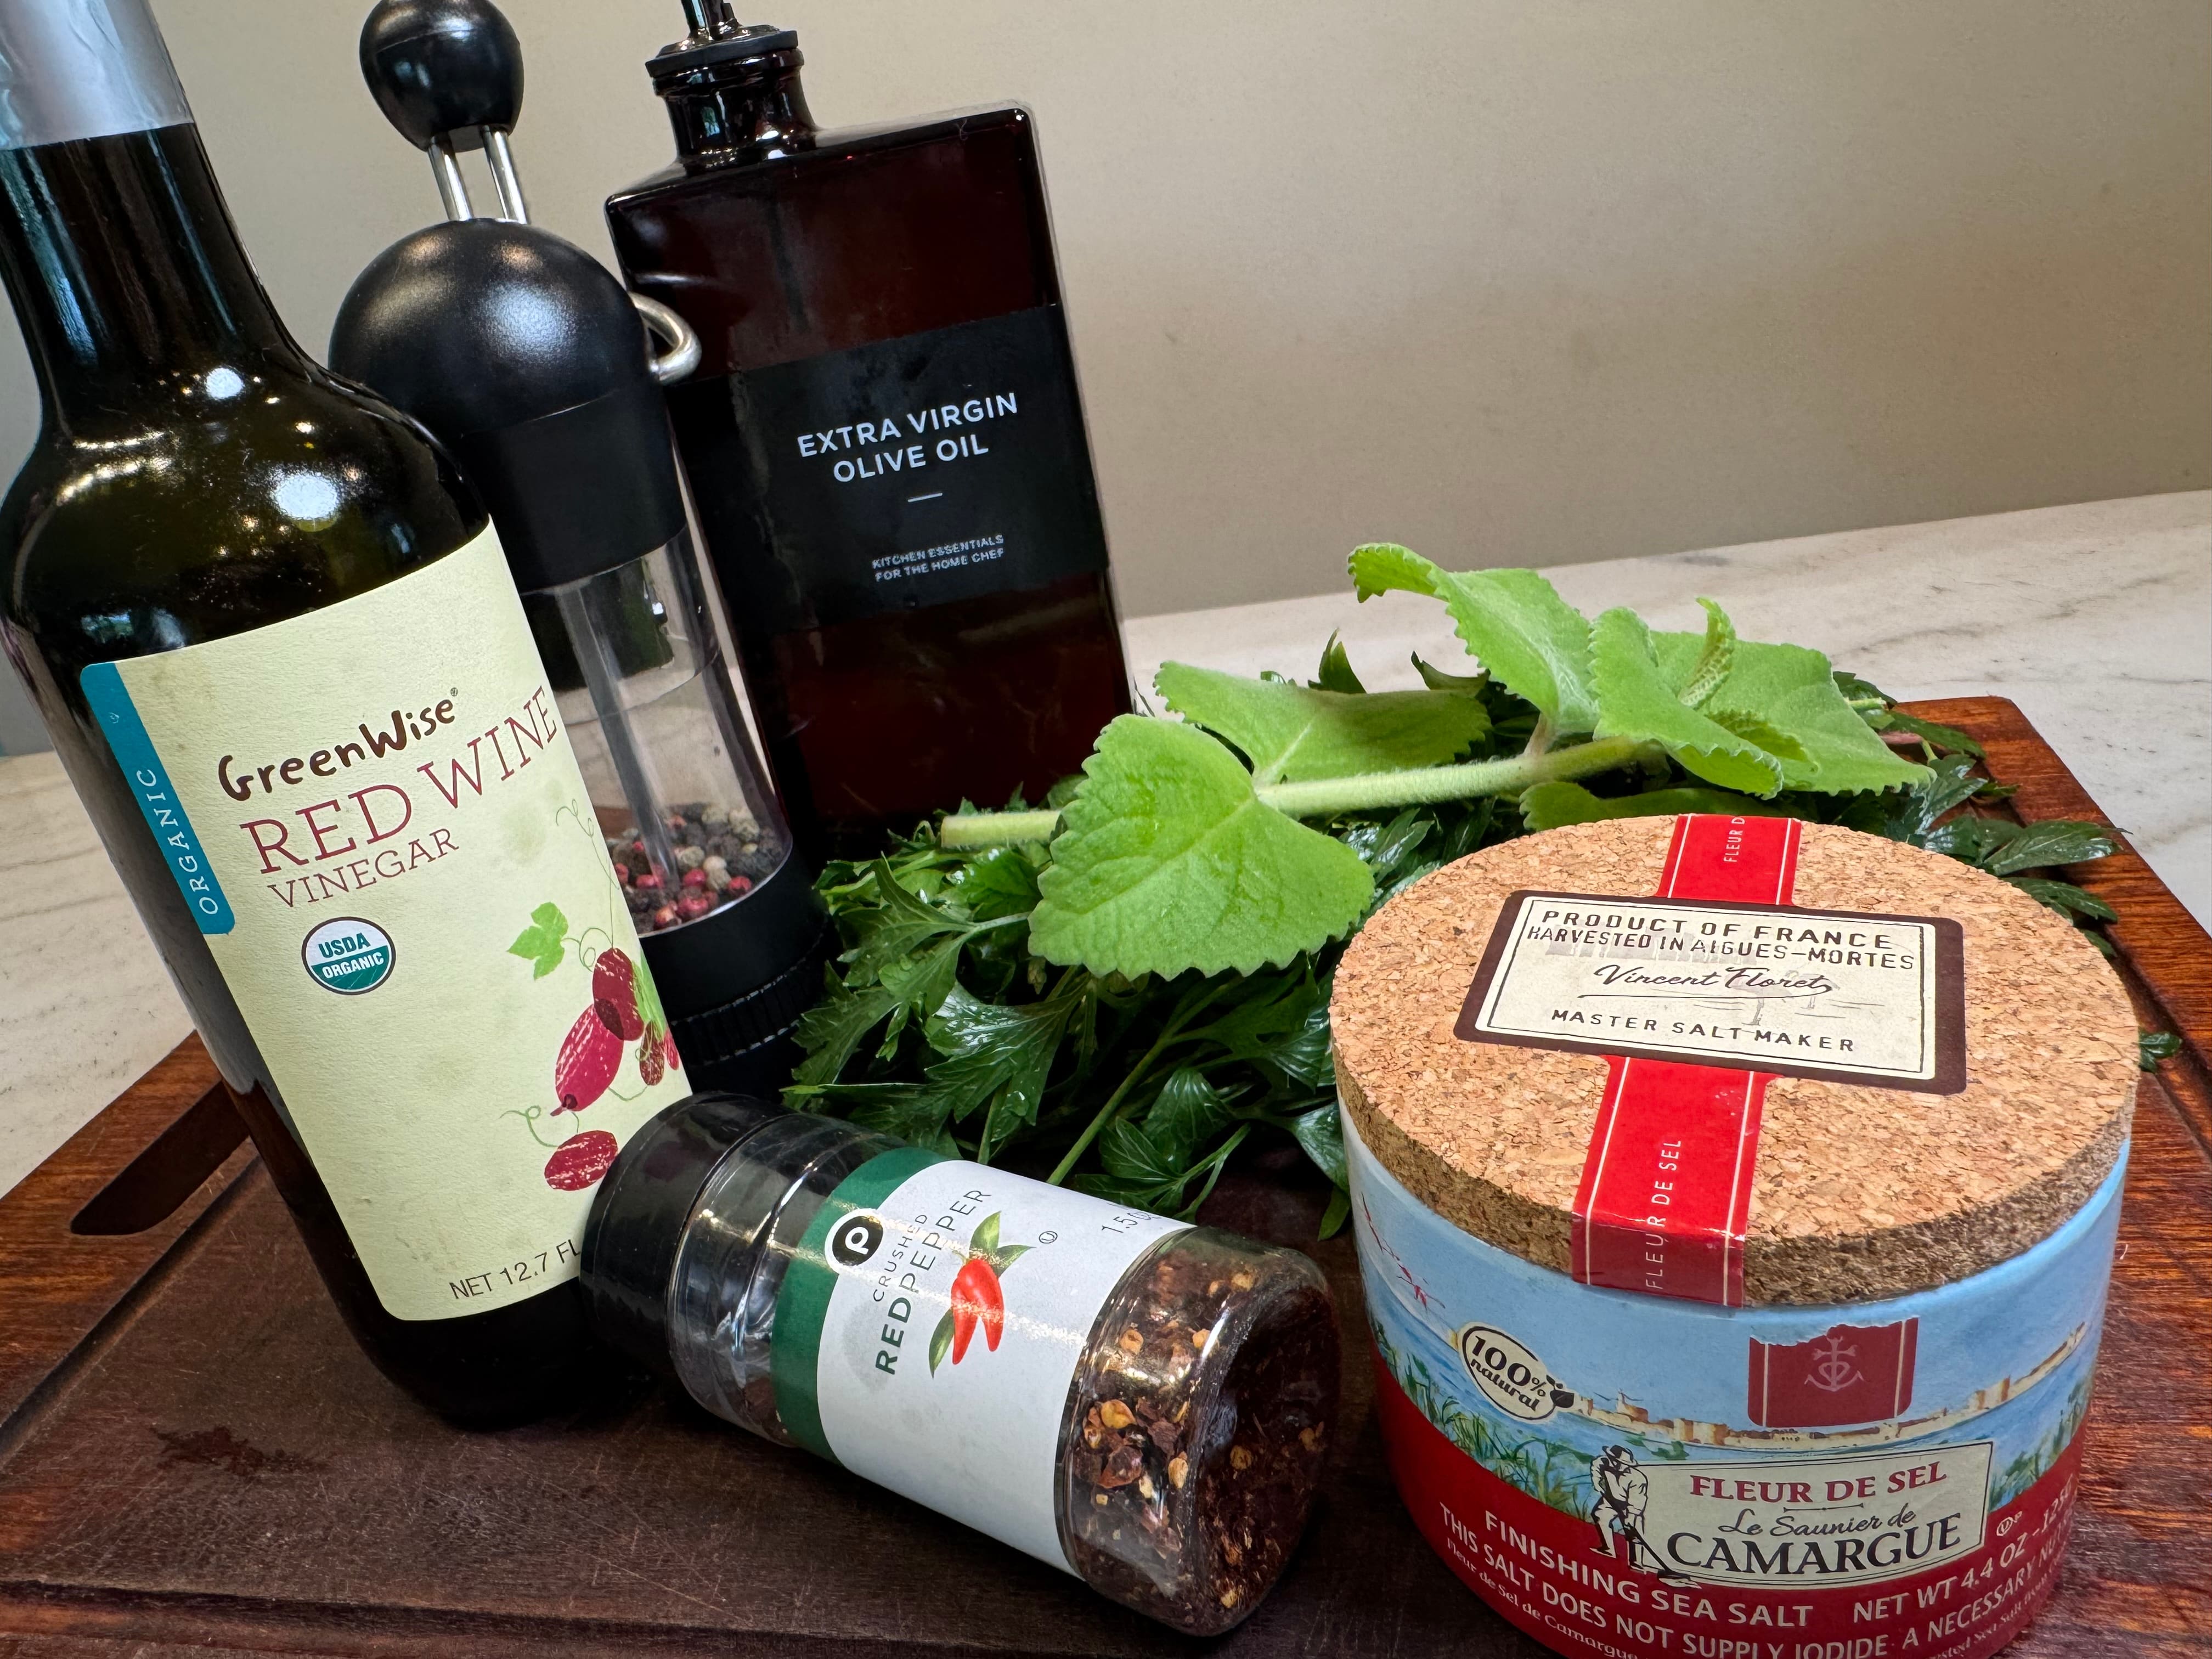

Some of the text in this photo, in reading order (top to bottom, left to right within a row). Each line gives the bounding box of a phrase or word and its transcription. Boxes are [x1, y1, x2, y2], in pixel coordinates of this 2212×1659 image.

[797, 392, 1018, 458] EXTRA VIRGIN
[833, 434, 989, 482] OLIVE OIL
[872, 534, 1004, 569] KITCHEN ESSENTIALS
[874, 548, 1004, 582] FOR THE HOME CHEF
[239, 685, 557, 874] RED WINE
[136, 769, 219, 915] ORGANIC
[267, 827, 459, 909] VINEGAR
[1723, 830, 1743, 862] FLEUR
[318, 933, 371, 958] USDA
[1527, 925, 1652, 948] HARVESTED
[1659, 935, 1684, 951] IN
[1542, 911, 1893, 950] PRODUCT OF FRANCE
[322, 952, 385, 979] ORGANIC
[1593, 964, 1722, 986] Vincent
[1551, 1009, 1854, 1052] MASTER SALT MAKER
[1645, 1140, 1681, 1290] FLEUR DE SEL
[449, 1239, 582, 1299] NET 12.7 FL
[873, 1214, 928, 1303] CRUSHED
[1470, 1358, 1541, 1412] natural
[1471, 1335, 1547, 1397] 100%
[1690, 1461, 1947, 1503] FLEUR DE SEL
[1667, 1512, 1961, 1575] CAMARGUE
[1718, 1502, 1917, 1537] Le Saunier de
[1439, 1501, 1479, 1554] THIS
[1483, 1543, 1535, 1591] SALT
[1542, 1581, 1607, 1628] DOES
[1616, 1613, 1674, 1649] NOT
[1682, 1633, 1784, 1659] SUPPLY
[1795, 1634, 1889, 1659] IODIDE
[1902, 1627, 1919, 1650] A
[1927, 1556, 2036, 1642] NECESSARY
[1485, 1510, 1640, 1604] FINISHING
[1651, 1590, 1718, 1622] SEA
[1728, 1603, 1813, 1627] SALT
[1853, 1592, 1910, 1624] NET
[1917, 1576, 1958, 1609] WT
[1961, 1557, 1993, 1589] 4.4
[2000, 1532, 2028, 1568] OZ
[1479, 1570, 1497, 1590] de
[1498, 1583, 1519, 1607] Sel
[1522, 1601, 1542, 1621] de
[1544, 1614, 1638, 1659] Camargue
